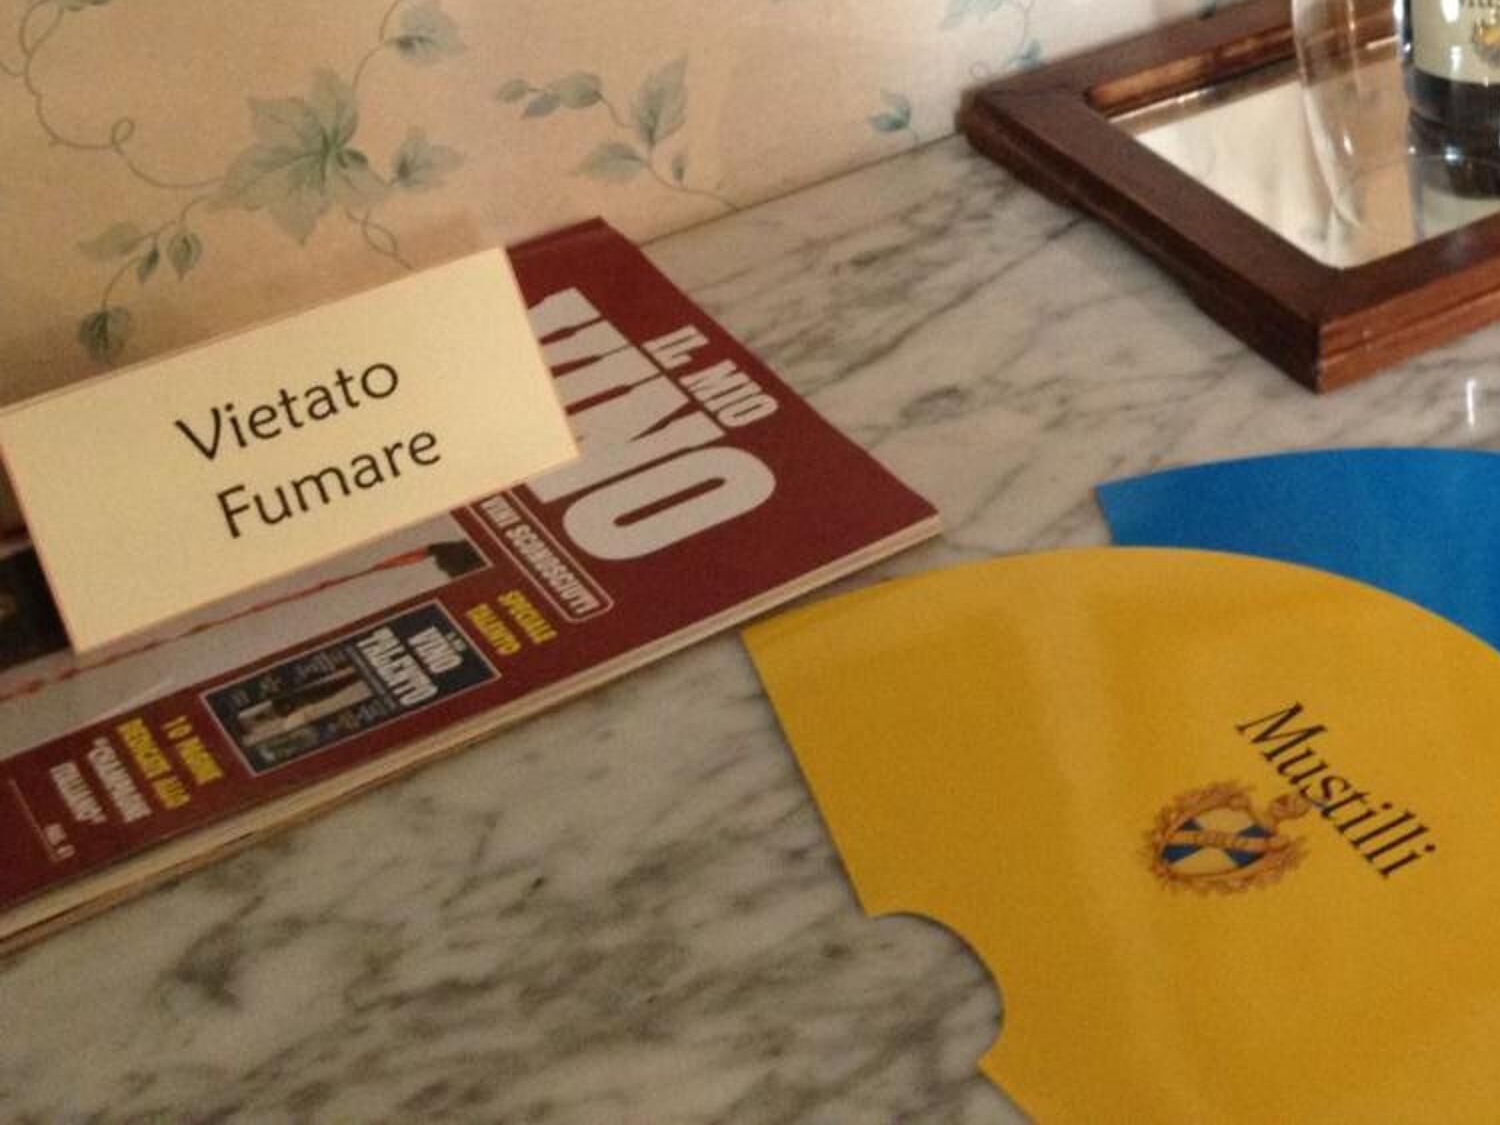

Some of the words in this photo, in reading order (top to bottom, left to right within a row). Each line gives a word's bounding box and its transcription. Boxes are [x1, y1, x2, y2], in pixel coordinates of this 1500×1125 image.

[175, 362, 399, 461] Vietato
[678, 360, 779, 427] MIO
[217, 431, 442, 538] Fumare
[1235, 701, 1437, 879] Mustilli
